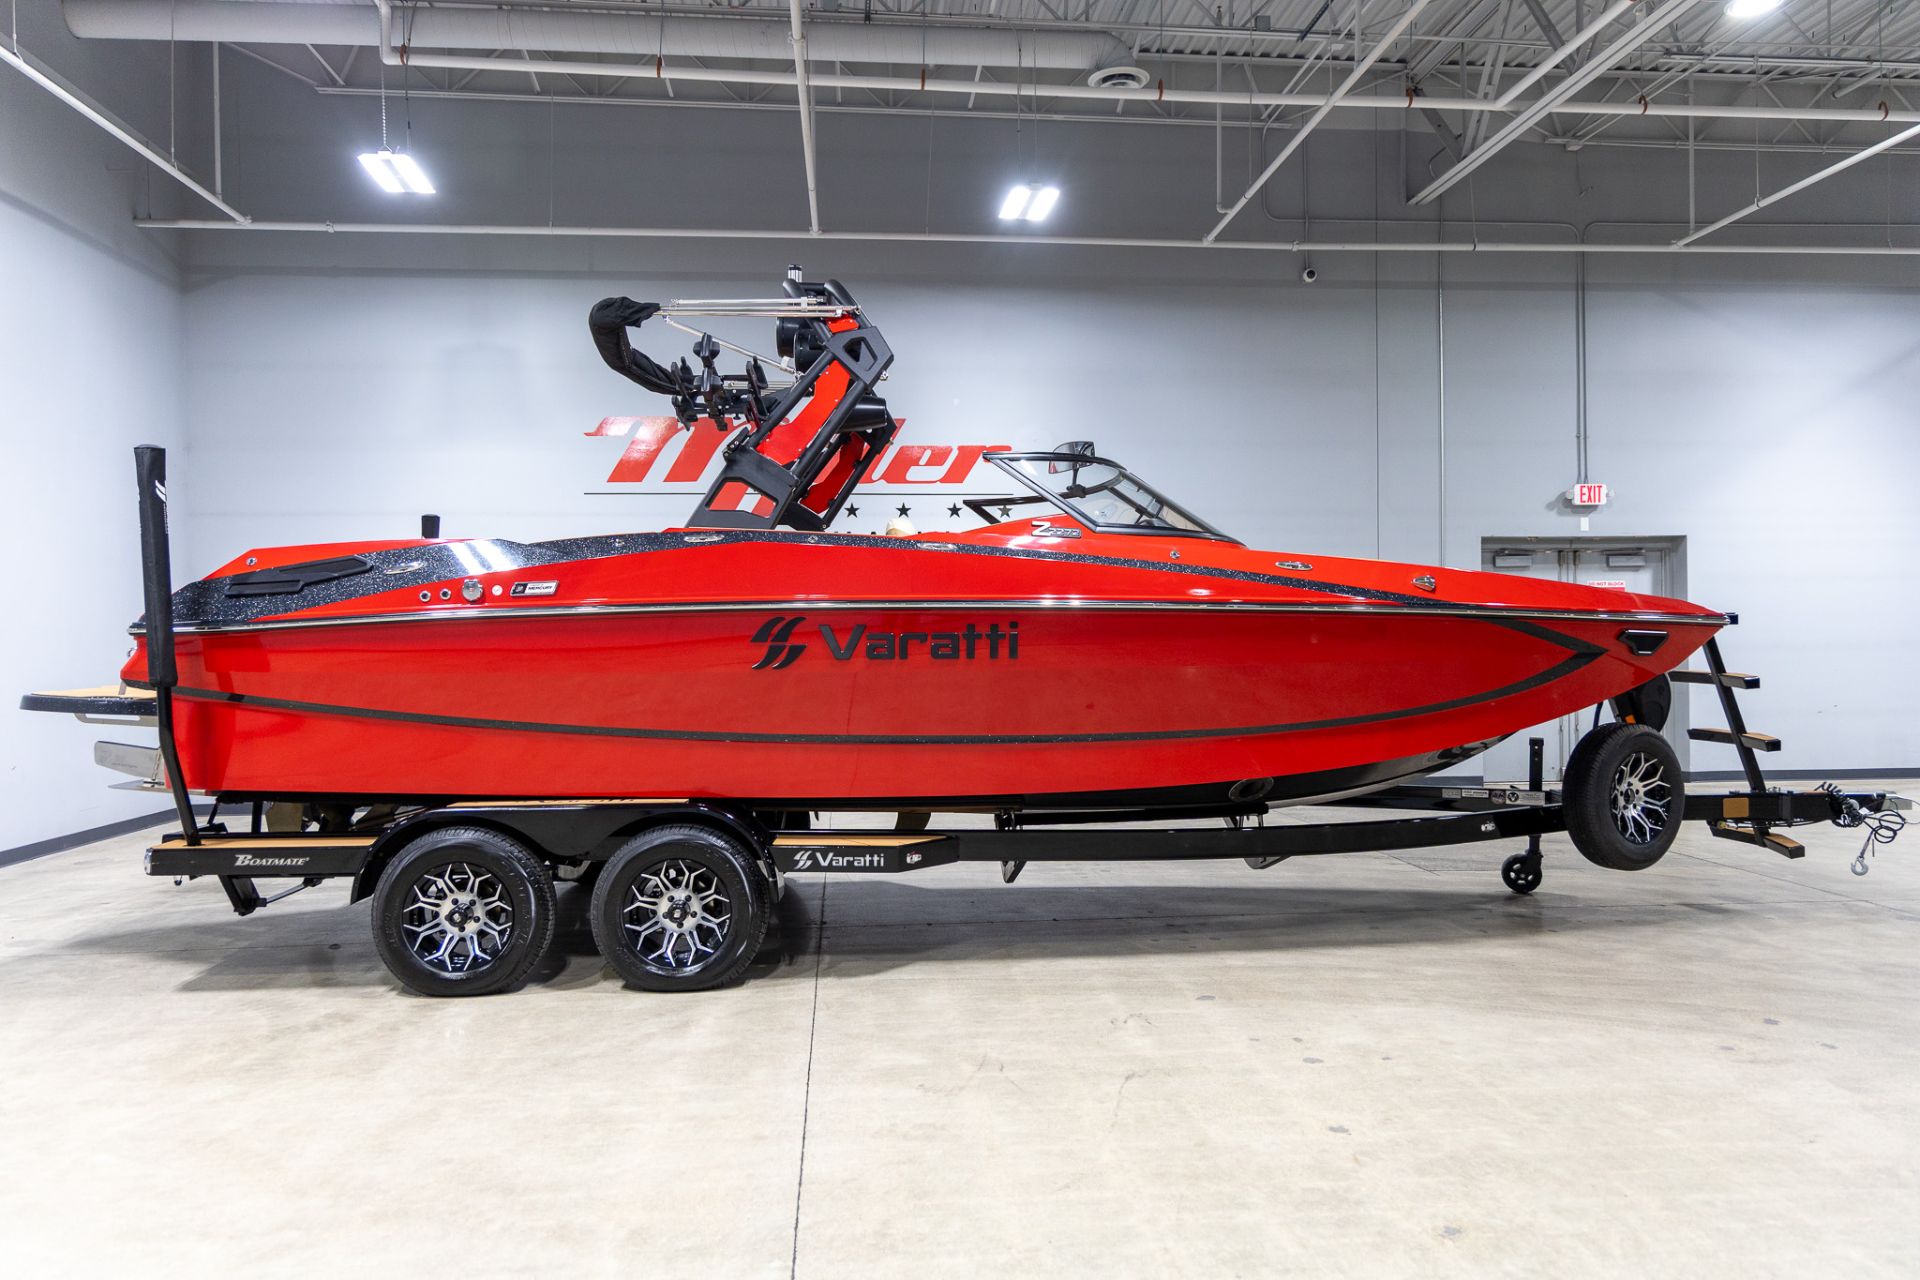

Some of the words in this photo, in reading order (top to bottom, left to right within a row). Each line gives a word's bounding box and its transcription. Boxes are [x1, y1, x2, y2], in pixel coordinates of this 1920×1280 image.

[1580, 485, 1603, 503] EXIT
[818, 621, 1019, 660] Varatti
[815, 852, 885, 867] Varatti
